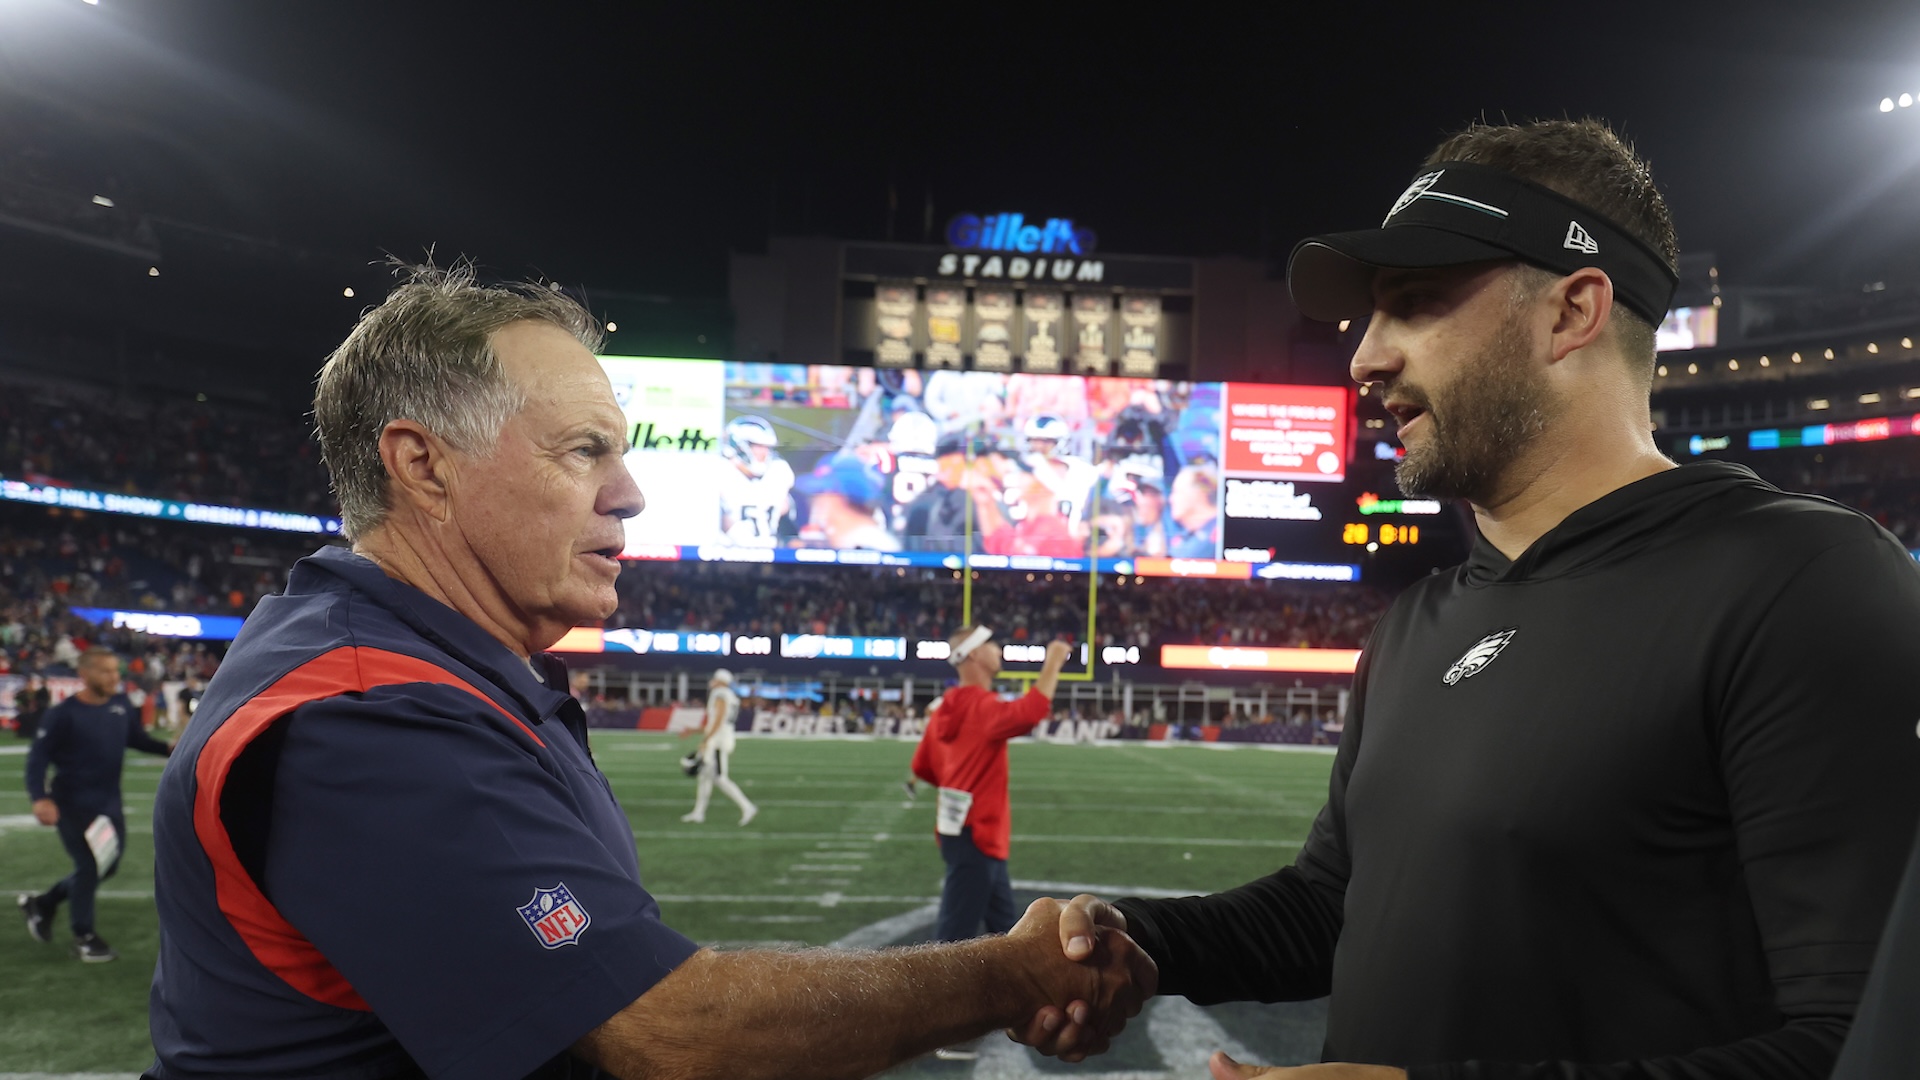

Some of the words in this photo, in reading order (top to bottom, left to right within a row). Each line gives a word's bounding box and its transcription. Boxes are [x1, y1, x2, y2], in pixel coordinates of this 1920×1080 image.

[948, 211, 1095, 255] Gillette
[938, 253, 1104, 282] STADIUM
[60, 487, 103, 509] HILL
[104, 494, 164, 516] SHOW
[536, 905, 585, 943] NFL
